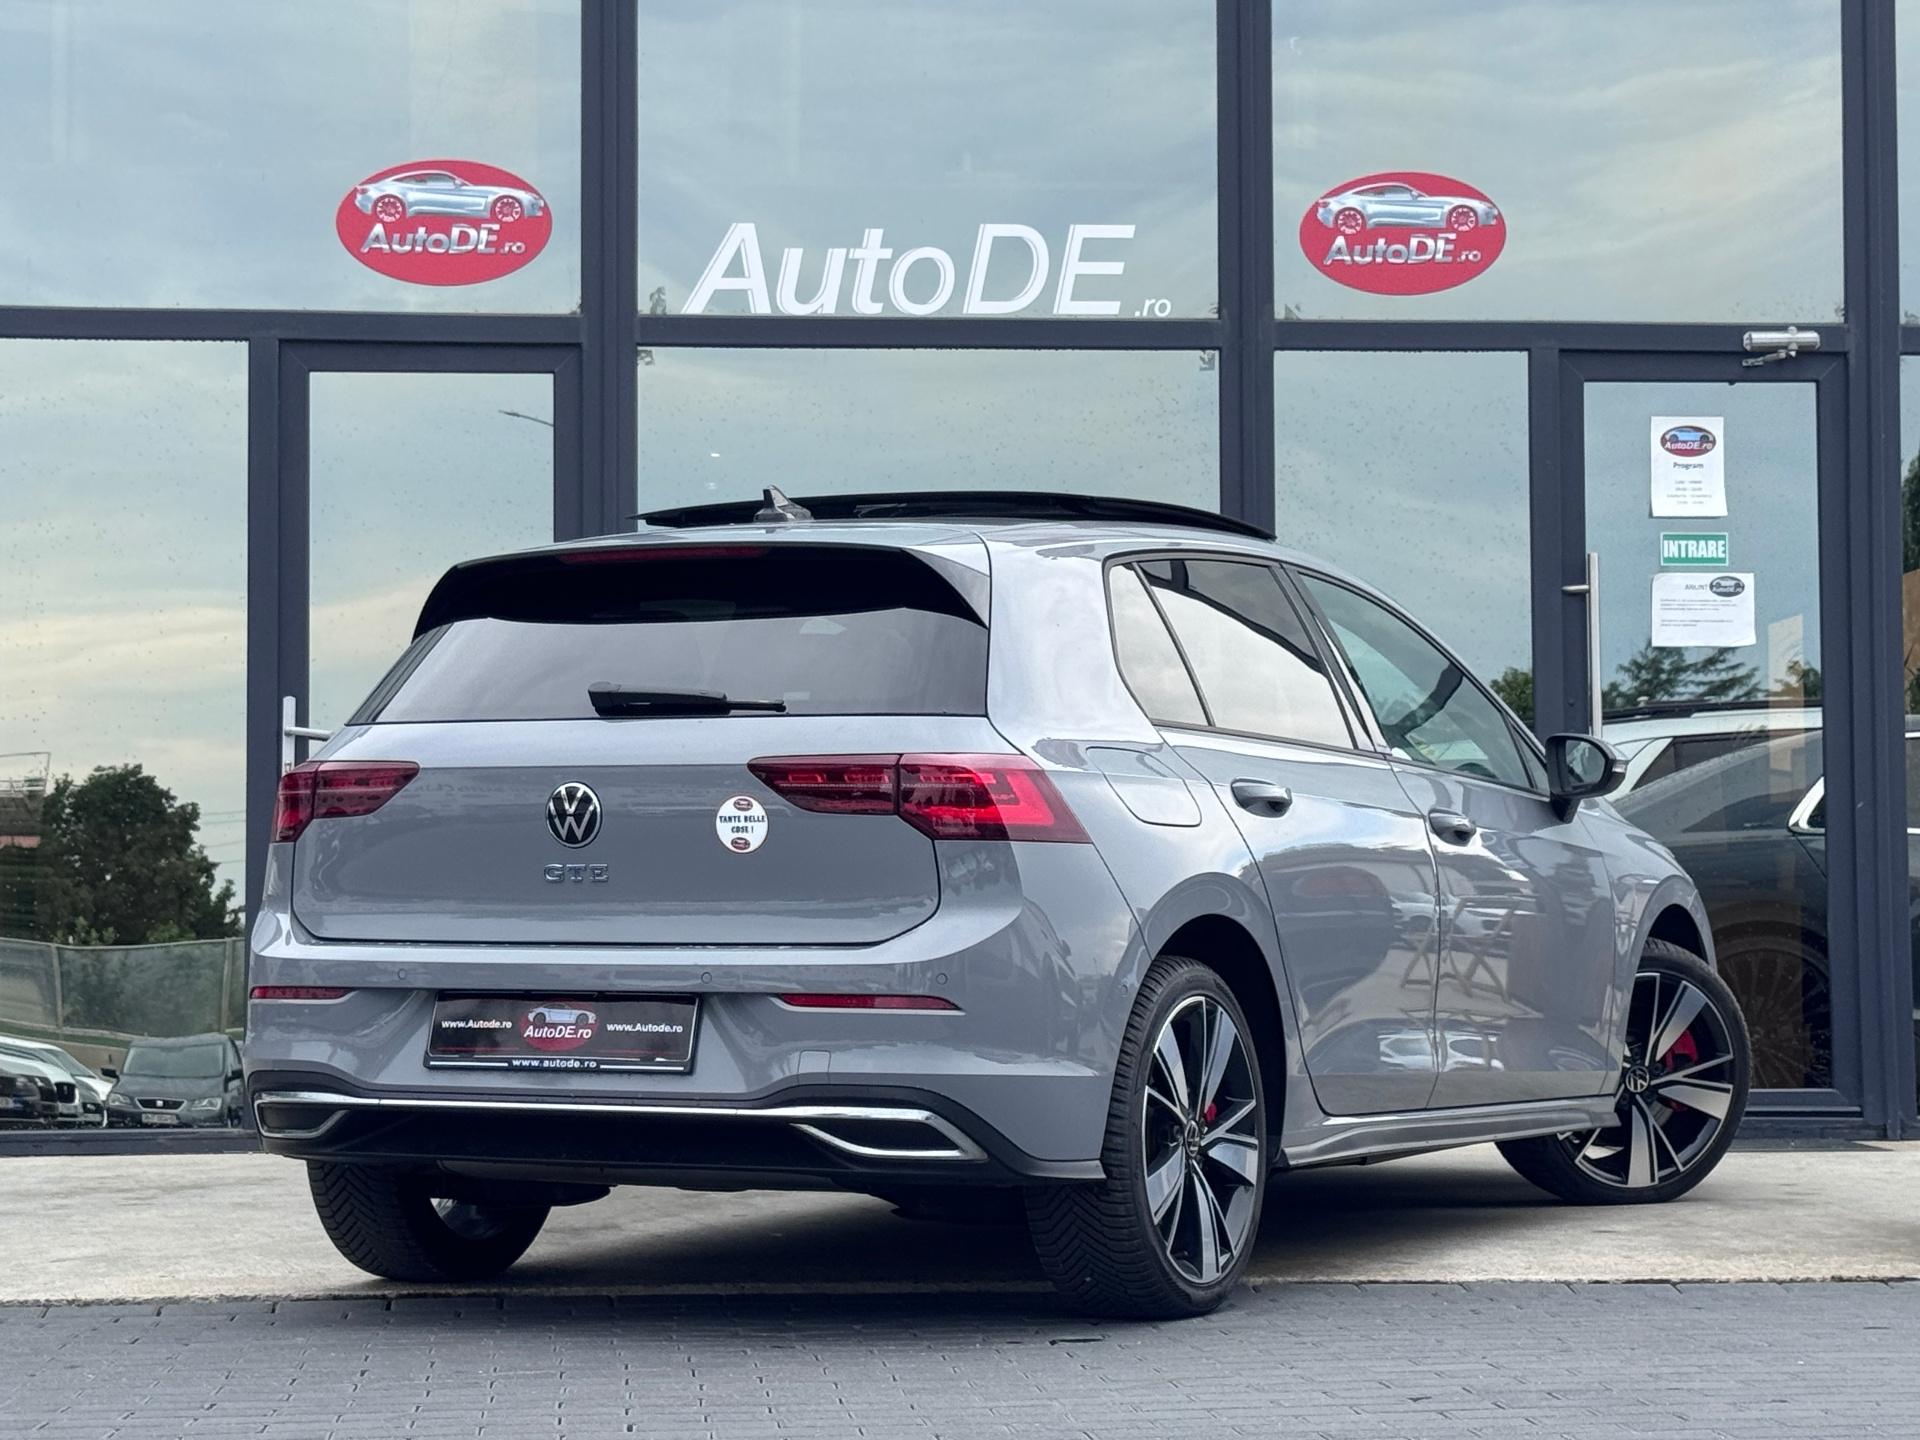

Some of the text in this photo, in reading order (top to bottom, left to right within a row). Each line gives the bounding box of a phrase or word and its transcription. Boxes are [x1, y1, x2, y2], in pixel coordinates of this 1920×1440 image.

[1673, 462, 1704, 470] Program
[1663, 540, 1726, 558] INTRARE
[719, 815, 765, 823] TANTE BELLE
[544, 863, 608, 883] GTE
[441, 1019, 513, 1029] www.Autode.ro
[606, 1022, 684, 1034] www.Autode.ro
[523, 1024, 593, 1040] AutoDE.ro
[511, 1058, 598, 1070] www.autode.ro
